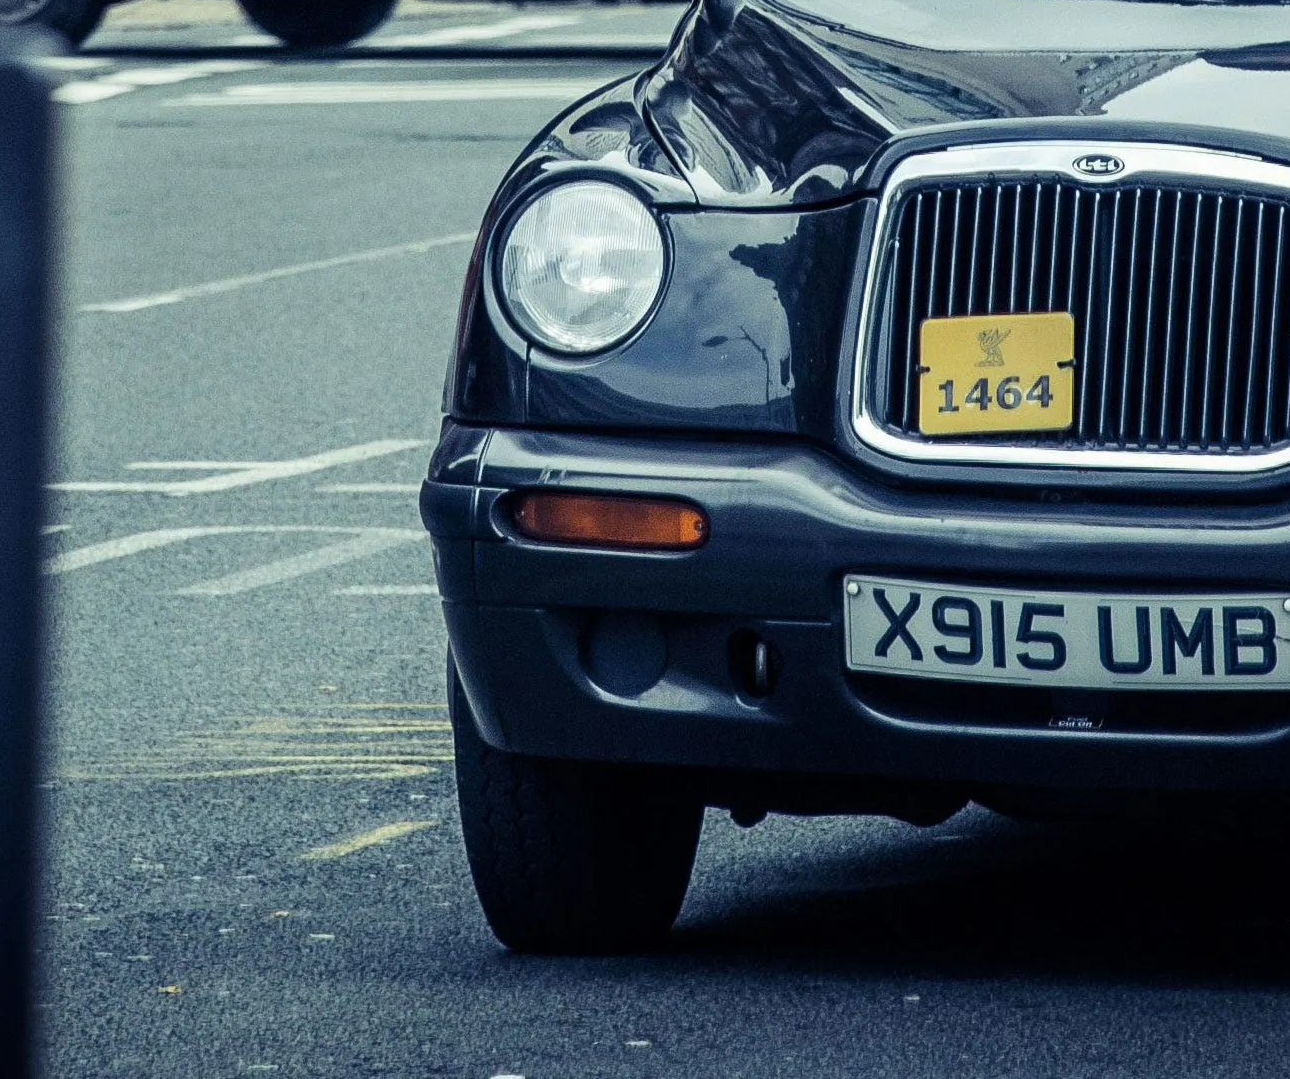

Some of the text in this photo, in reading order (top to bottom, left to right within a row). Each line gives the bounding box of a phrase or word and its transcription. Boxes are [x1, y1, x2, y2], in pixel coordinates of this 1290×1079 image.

[938, 374, 1054, 414] 1464
[872, 587, 1278, 676] X915 UMB
